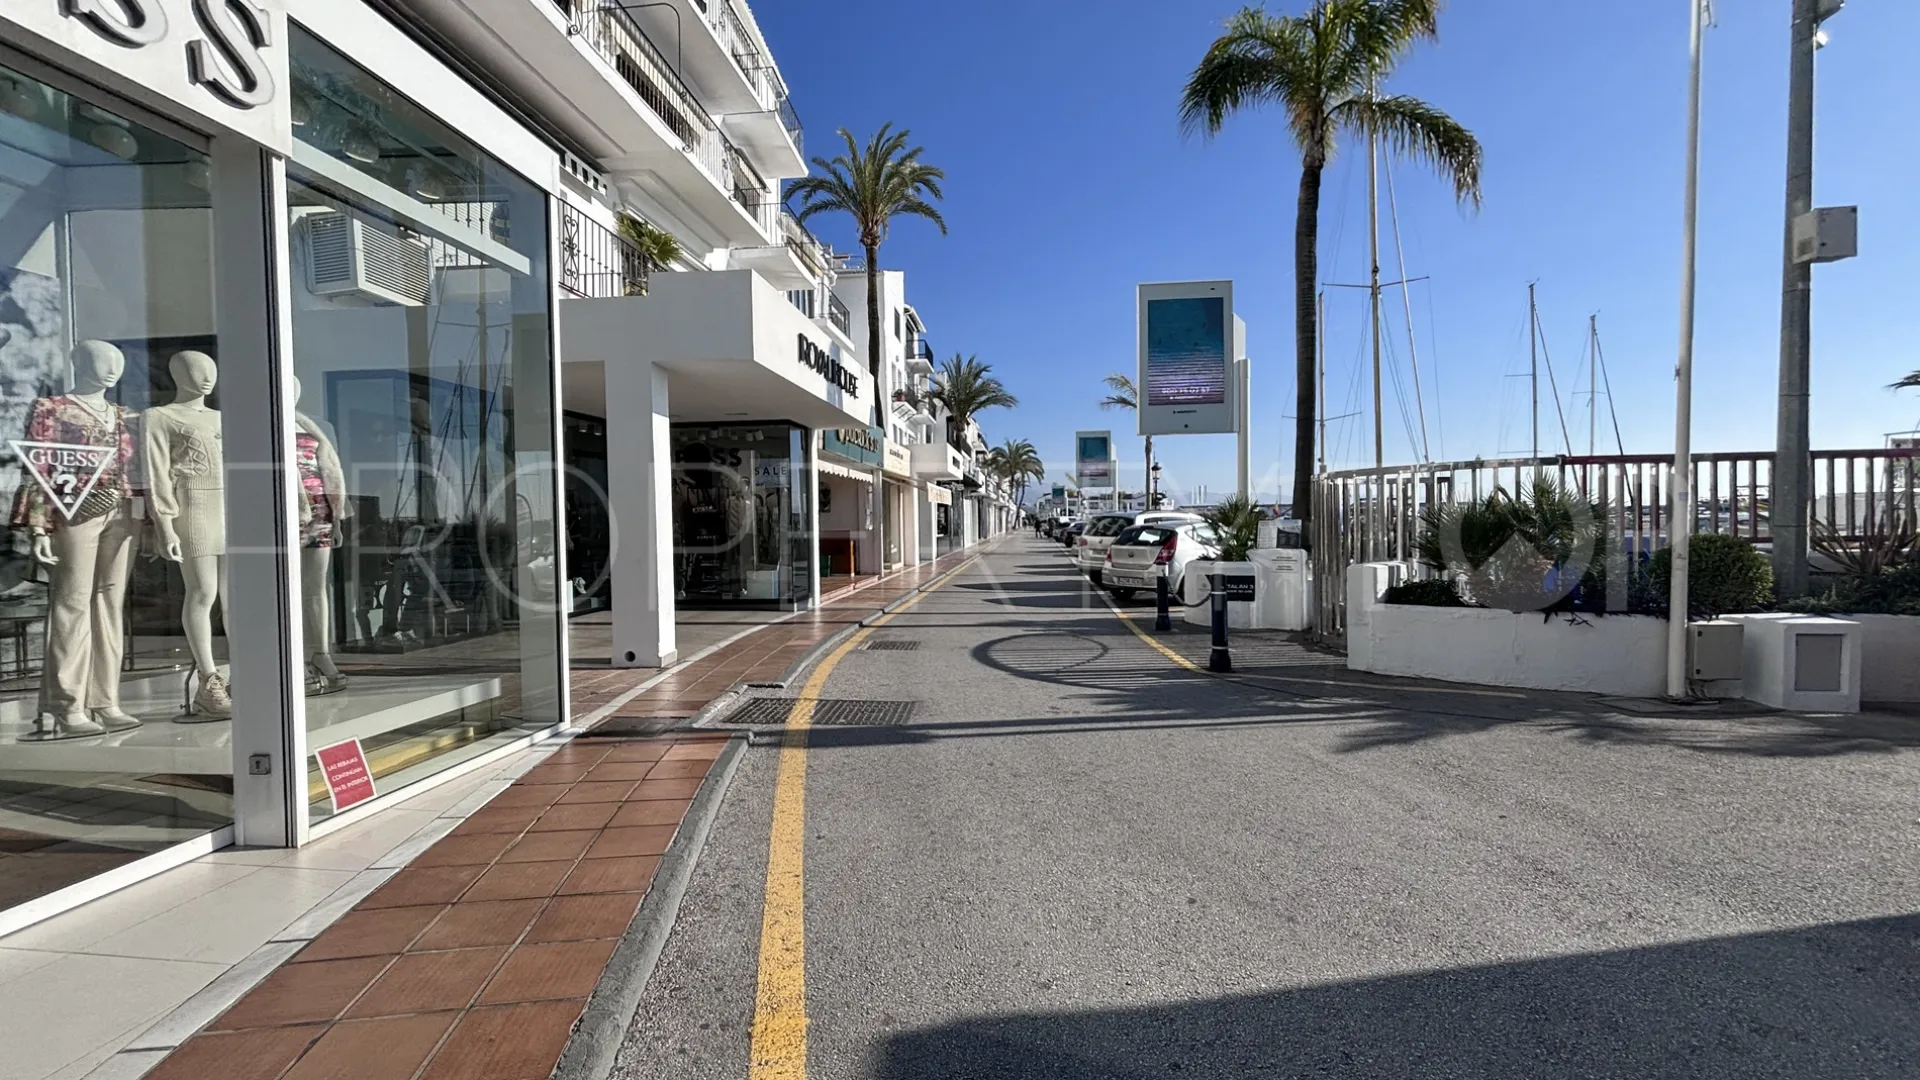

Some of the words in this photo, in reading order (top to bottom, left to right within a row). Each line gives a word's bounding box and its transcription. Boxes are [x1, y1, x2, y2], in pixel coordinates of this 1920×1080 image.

[28, 449, 100, 467] GUESS
[675, 447, 742, 467] BSS
[754, 466, 787, 476] SALE
[326, 763, 337, 771] LAS
[337, 756, 358, 768] REBAJAS
